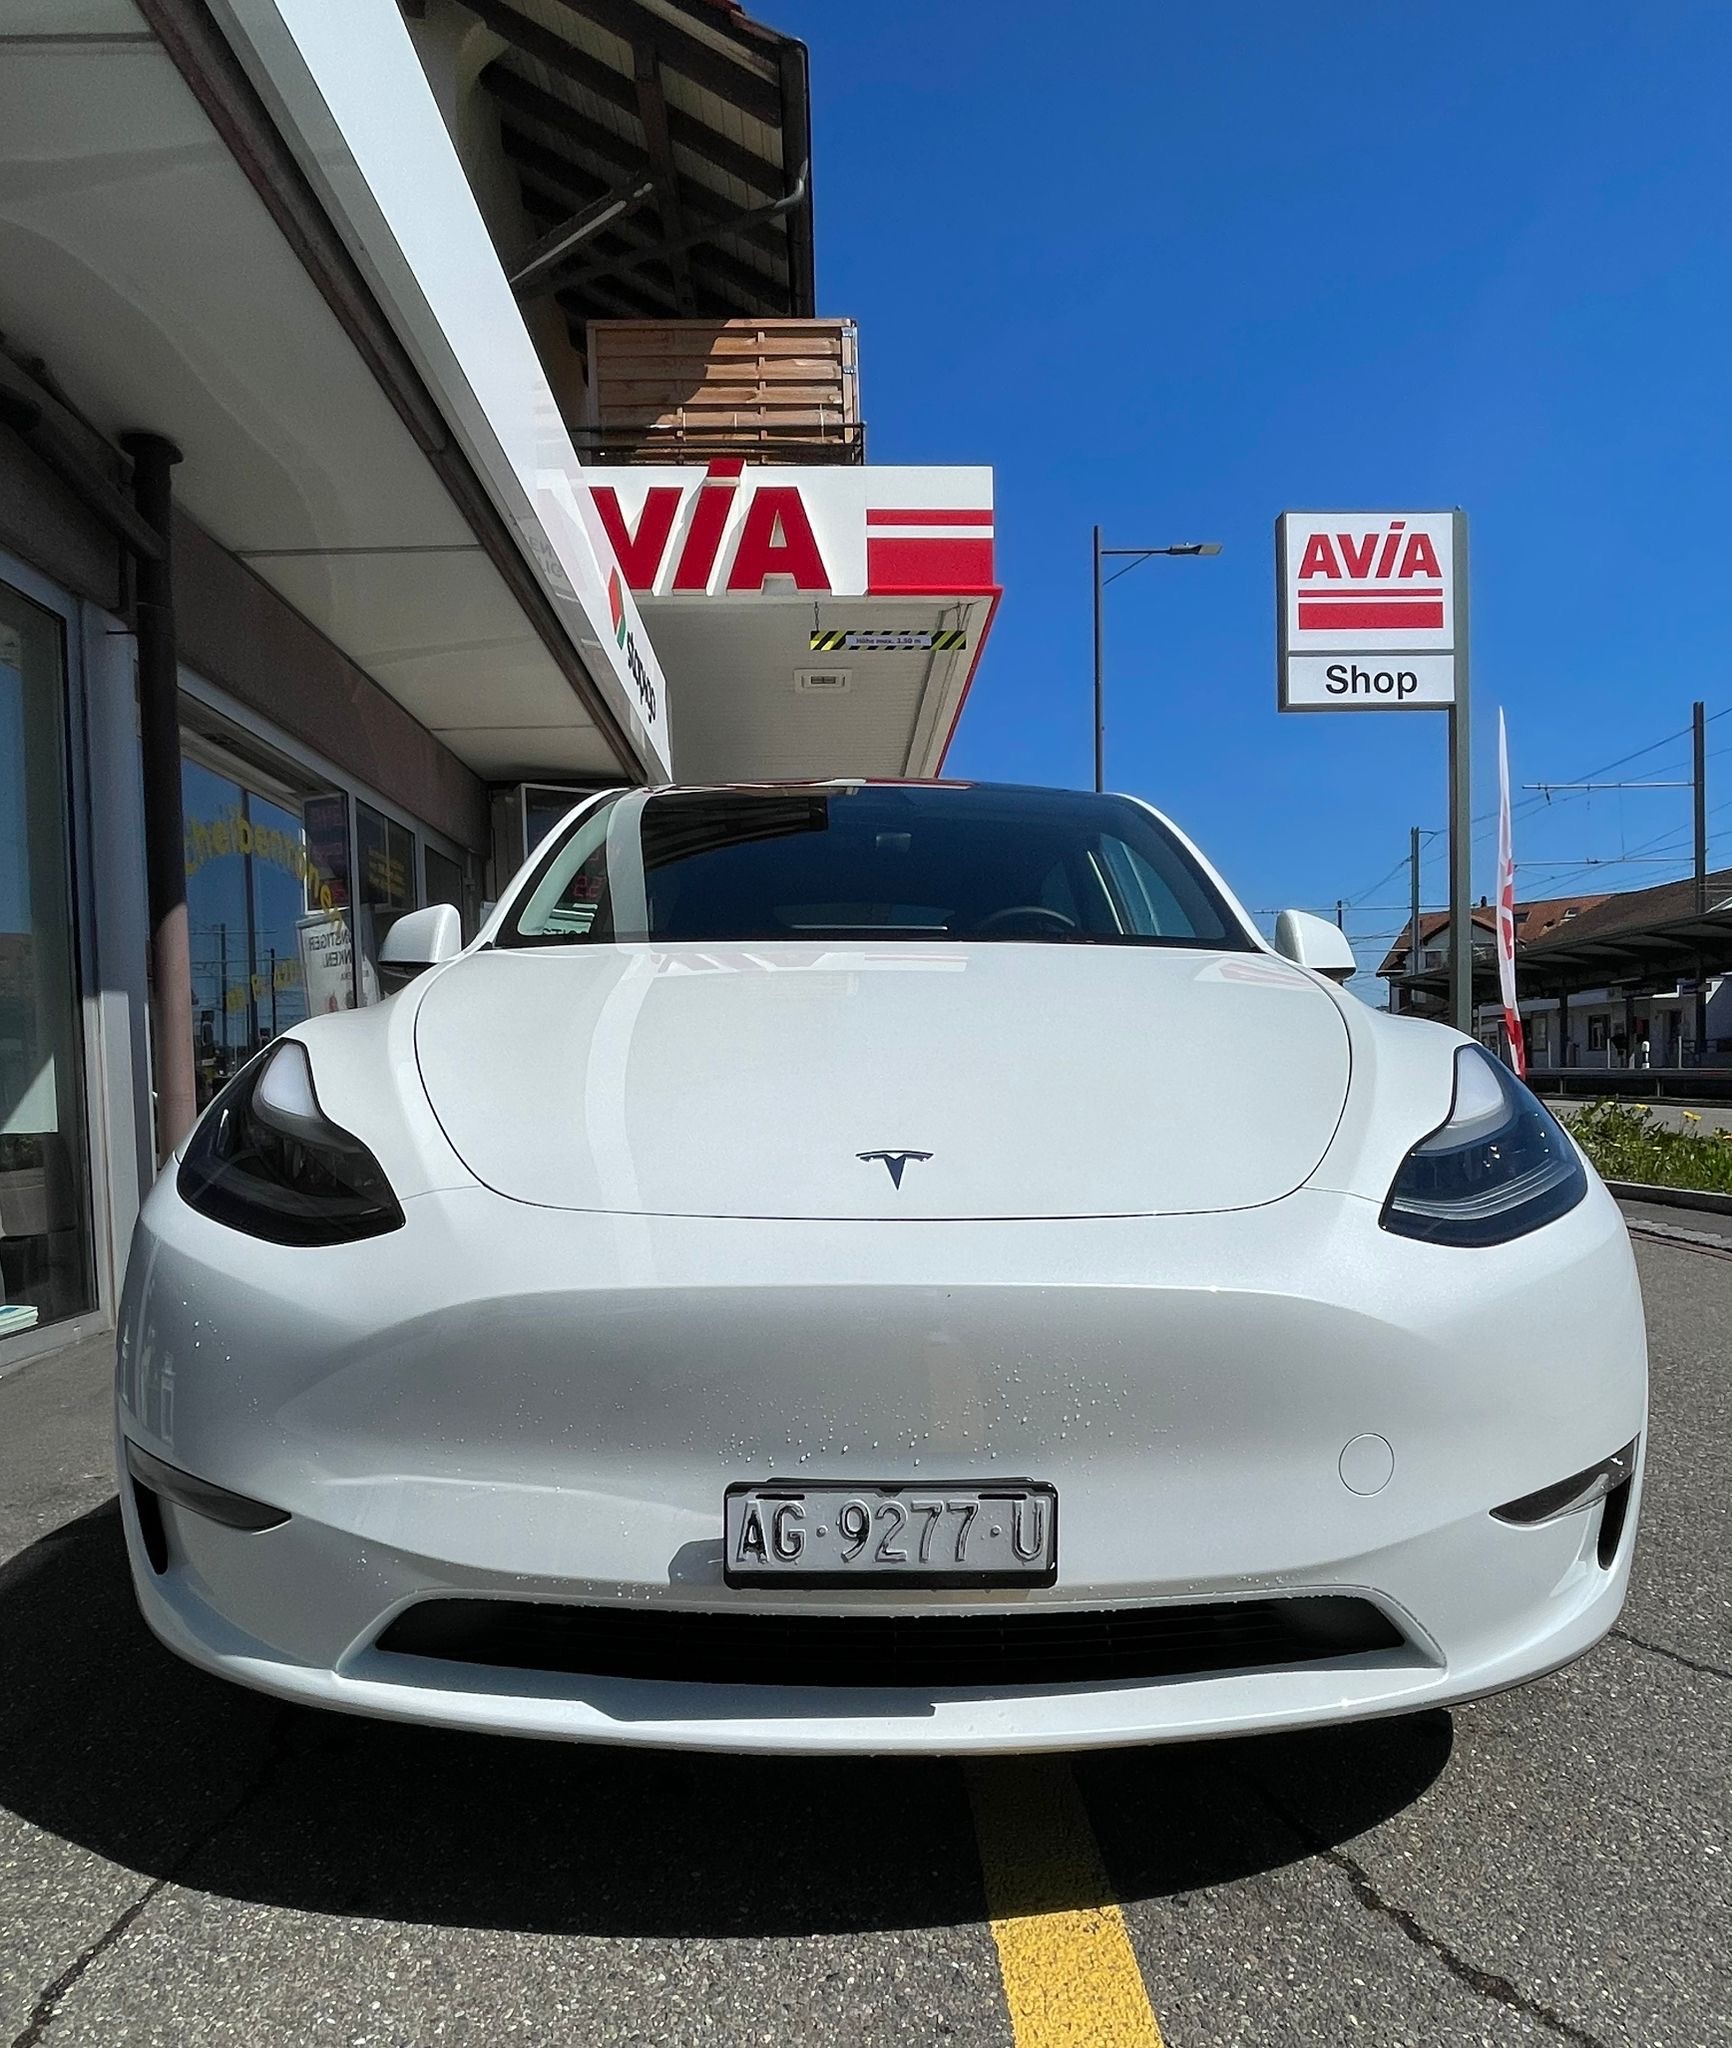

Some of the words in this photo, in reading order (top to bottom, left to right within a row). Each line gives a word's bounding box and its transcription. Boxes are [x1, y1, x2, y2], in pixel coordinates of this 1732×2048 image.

[588, 458, 831, 590] VIA
[1298, 521, 1443, 579] AVIA
[1325, 664, 1418, 700] Shop
[736, 1499, 807, 1563] AG
[837, 1499, 980, 1563] 9277
[1011, 1499, 1047, 1562] U
